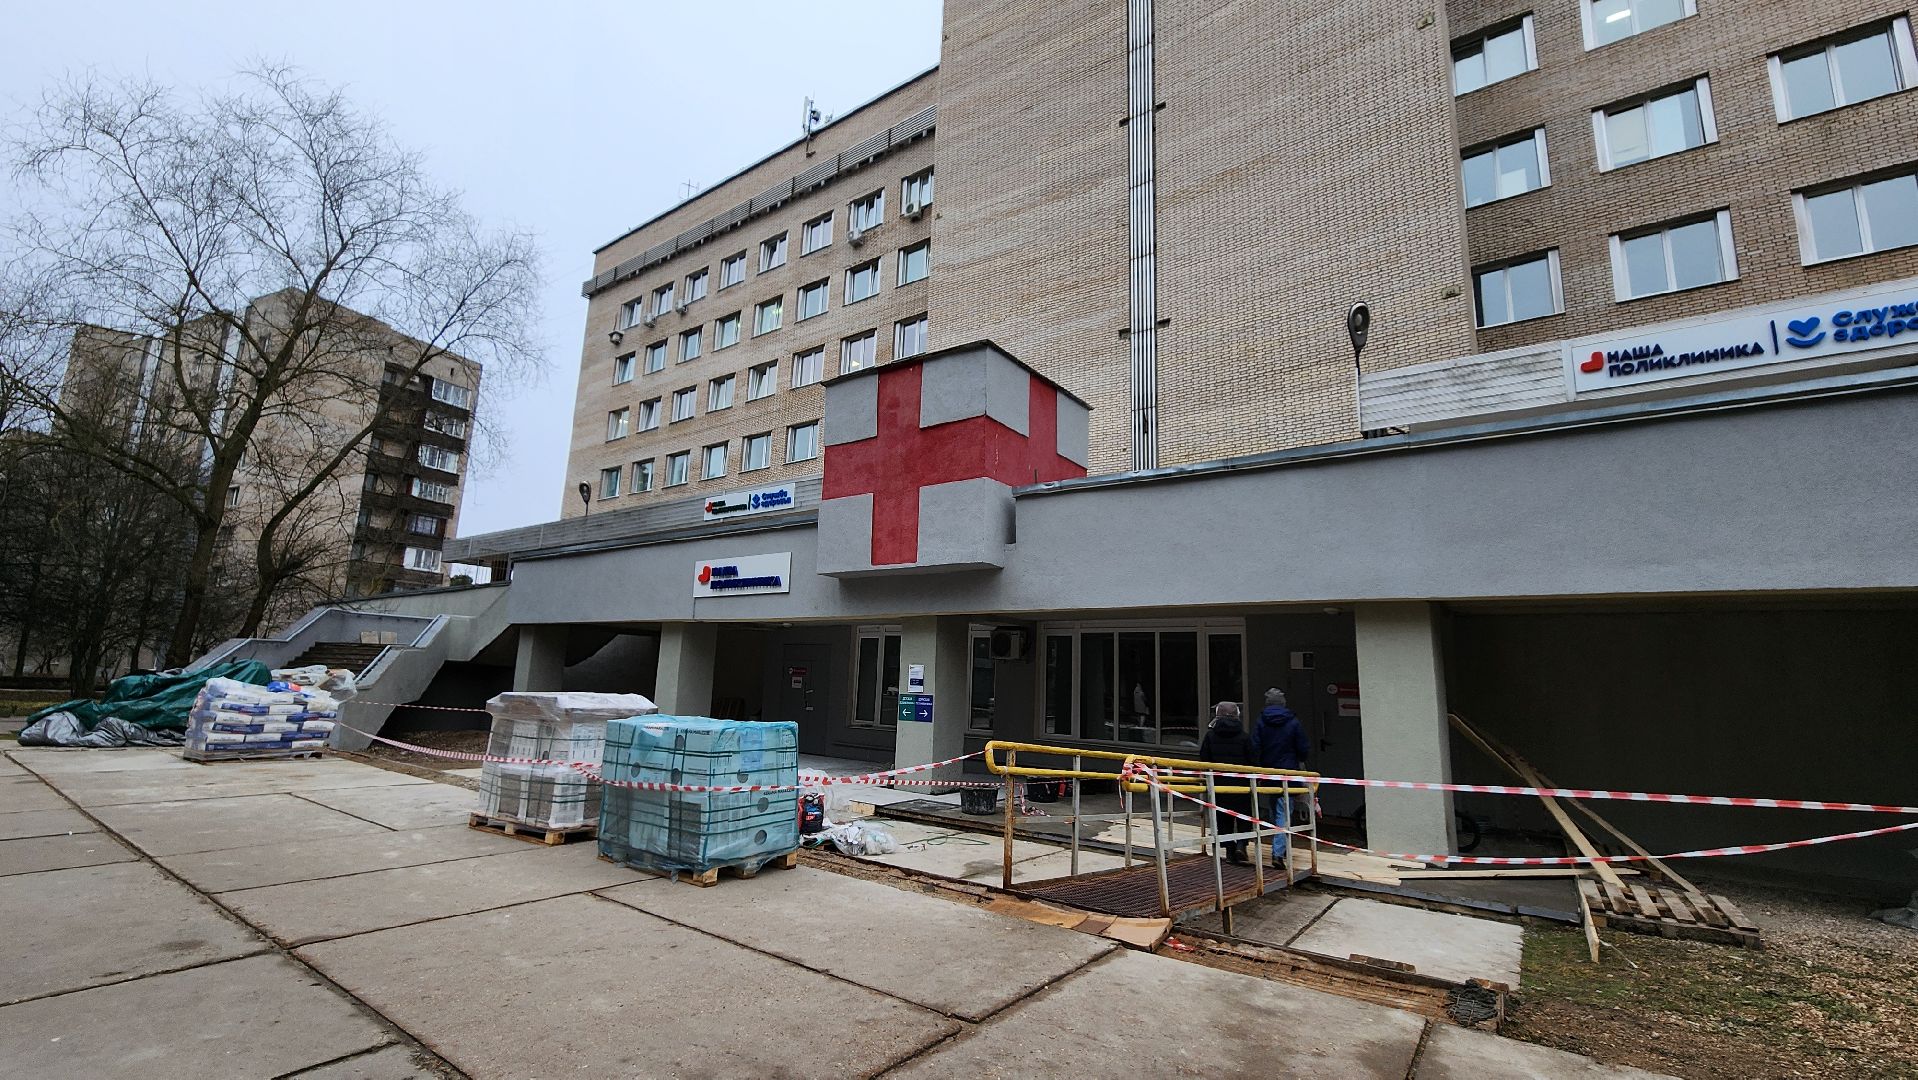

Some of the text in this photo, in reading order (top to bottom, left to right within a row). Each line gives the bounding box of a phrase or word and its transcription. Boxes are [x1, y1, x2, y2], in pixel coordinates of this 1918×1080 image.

[1831, 301, 1918, 328] Служ
[1607, 343, 1664, 364] НАША
[1608, 341, 1765, 378] ПОЛИКЛИНИКА
